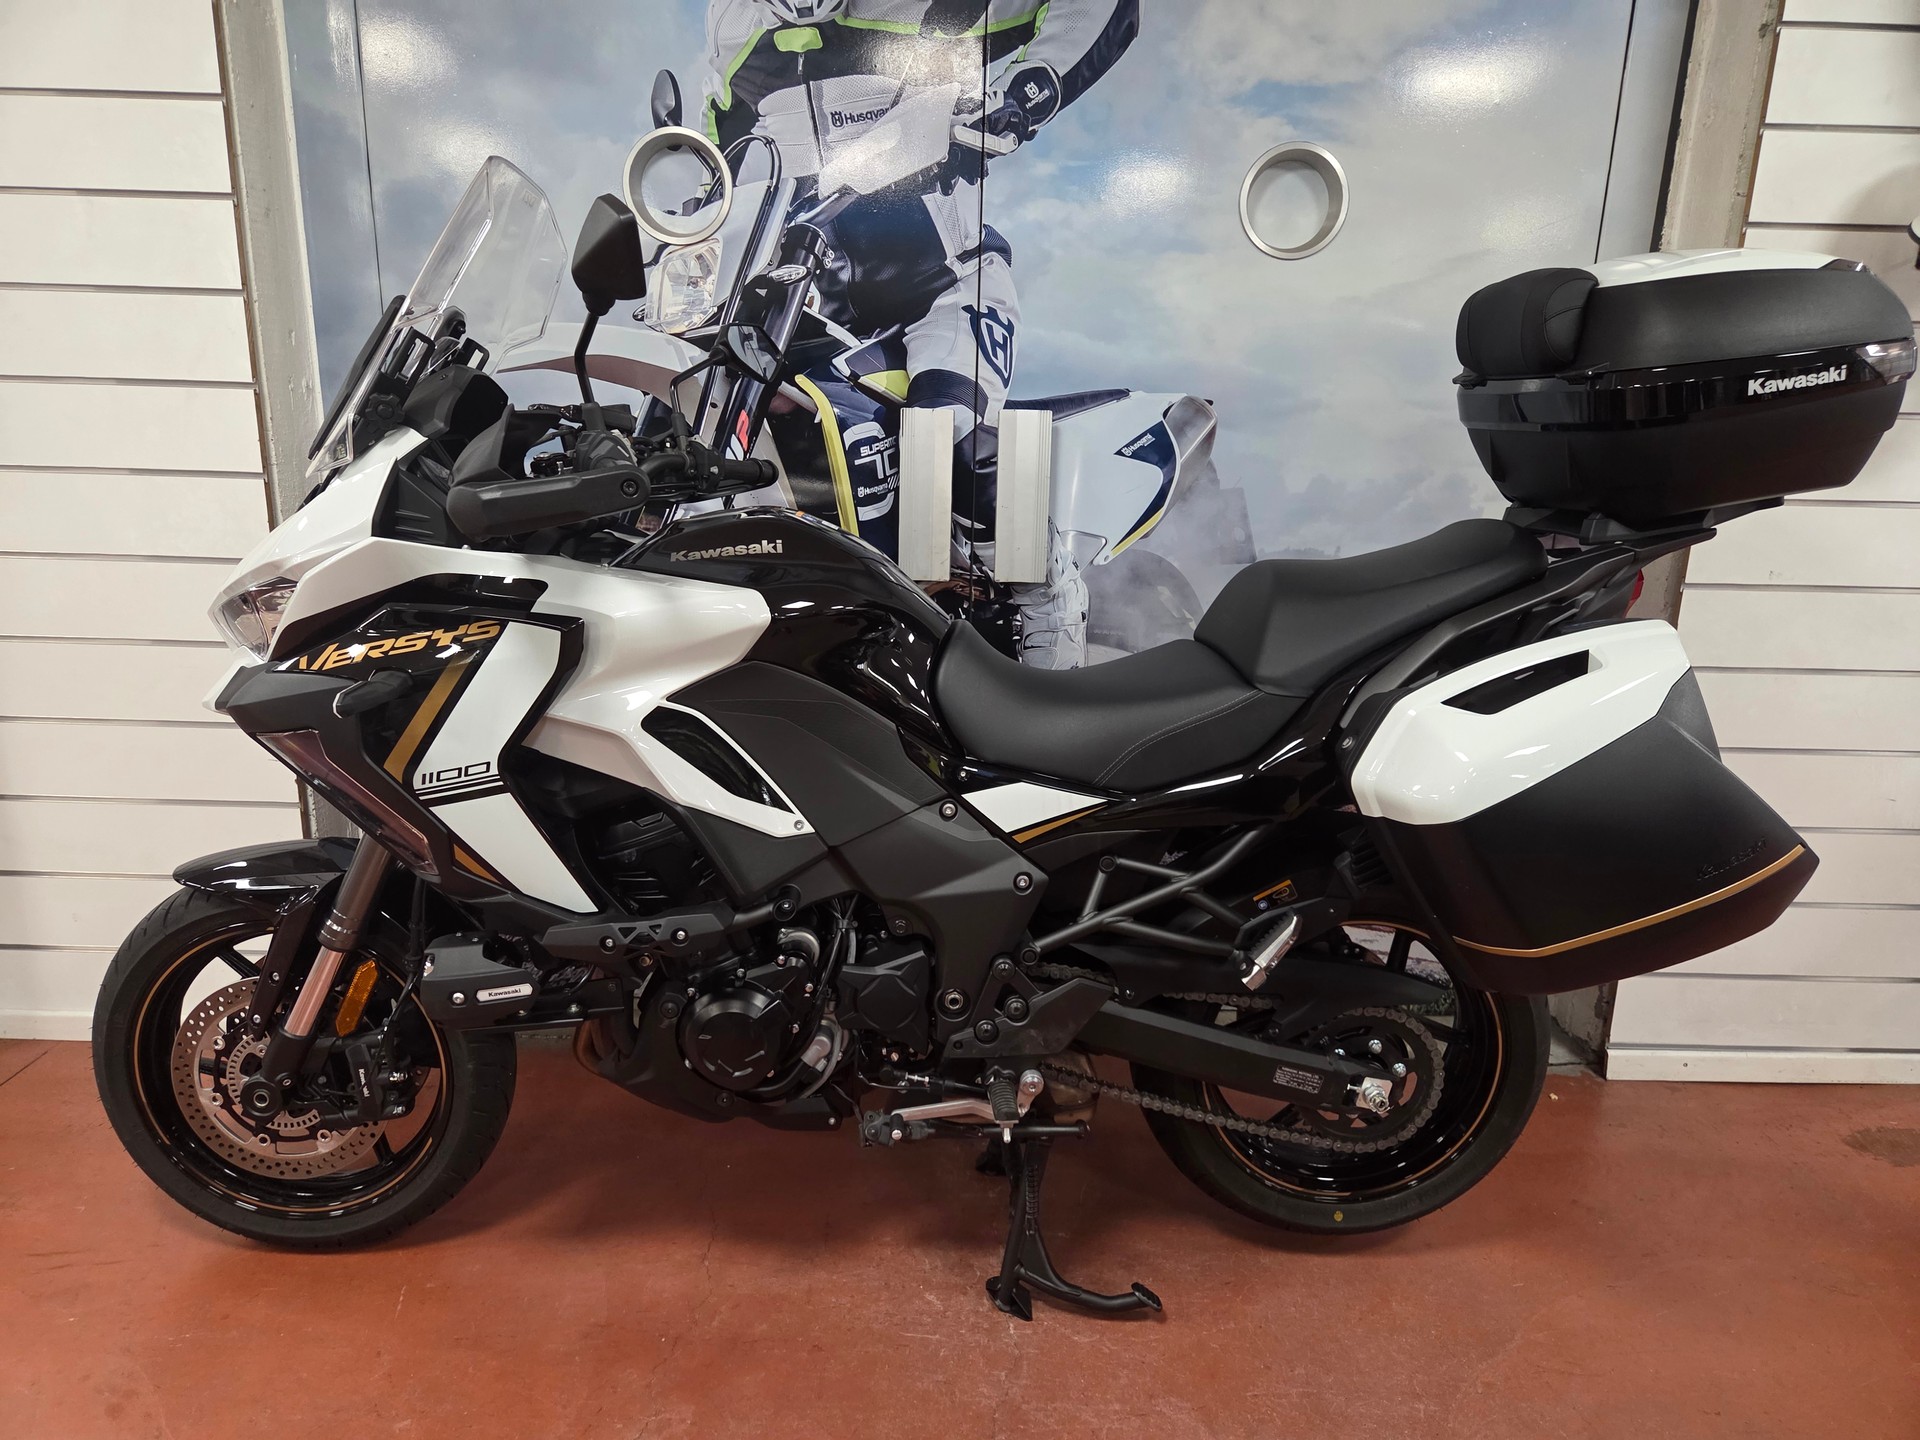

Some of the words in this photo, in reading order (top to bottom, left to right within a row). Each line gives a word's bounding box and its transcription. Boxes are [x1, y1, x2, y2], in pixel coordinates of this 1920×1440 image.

[1747, 364, 1848, 396] Kawasaki
[670, 540, 783, 562] Kawasaki
[421, 761, 491, 785] 1100
[488, 988, 522, 997] Kawasaki
